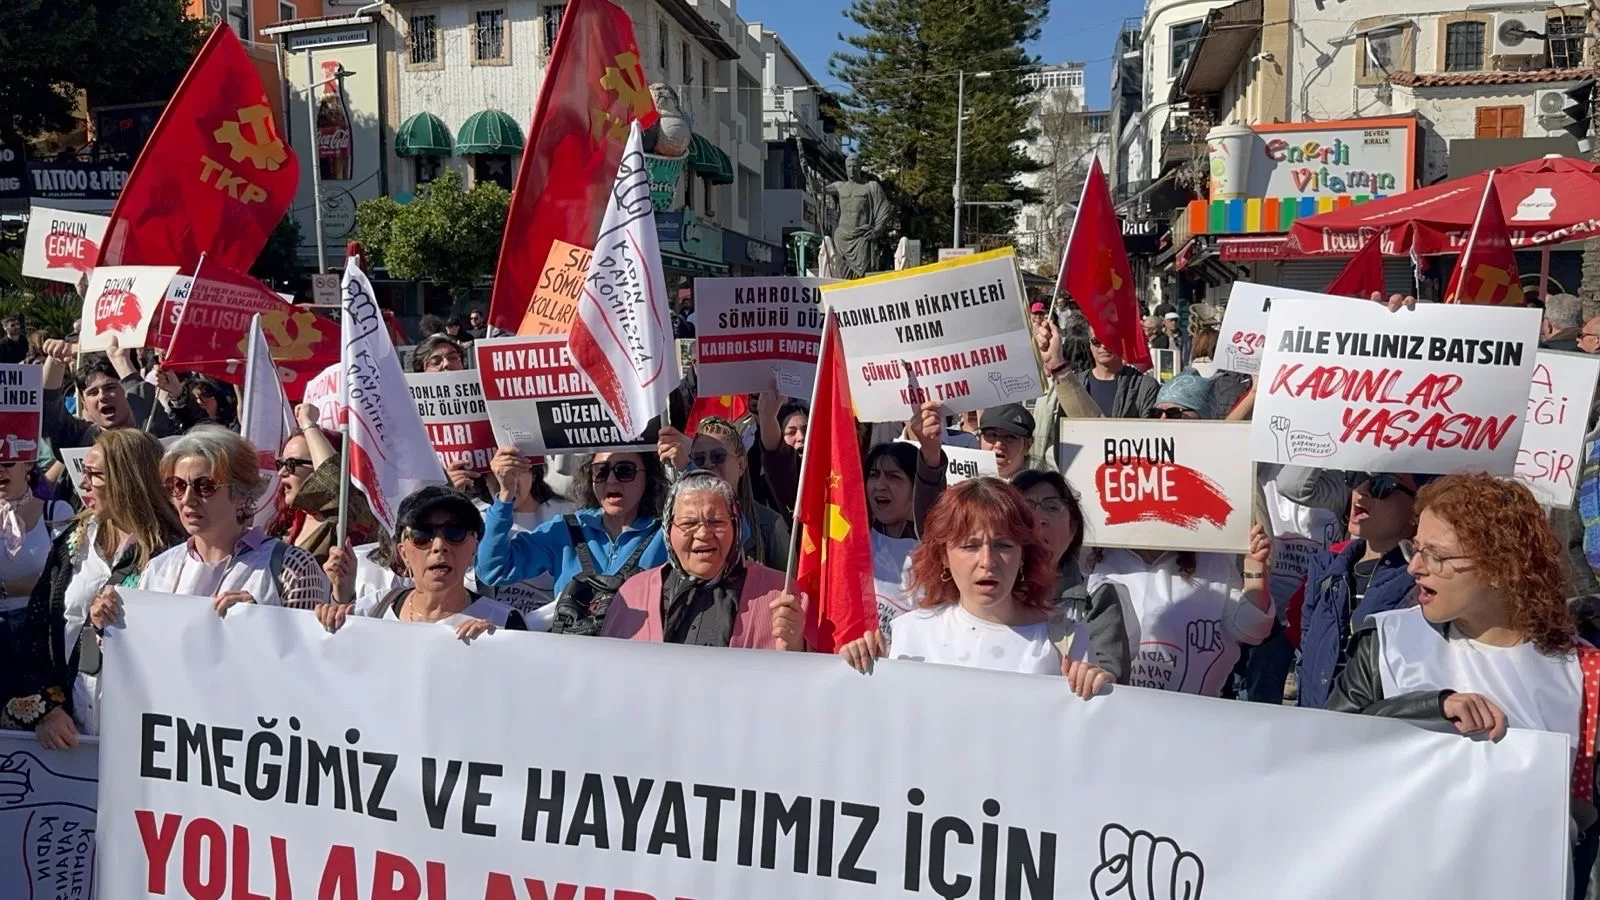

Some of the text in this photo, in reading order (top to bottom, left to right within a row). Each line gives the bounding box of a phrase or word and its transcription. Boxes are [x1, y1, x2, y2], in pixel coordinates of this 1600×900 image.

[31, 169, 88, 190] TATTOO
[89, 171, 101, 190] &
[200, 155, 267, 205] TKP
[51, 219, 87, 239] BOYUN
[540, 266, 587, 302] SÖMÜ
[612, 240, 646, 304] KADIN
[102, 276, 137, 297] BOYUN
[735, 286, 822, 304] KAHROLSU
[834, 279, 1006, 328] KADINLARIN HİKAYELERİ
[718, 307, 826, 329] SÖMÜRÜ DÜZ
[895, 319, 944, 344] YARIM
[492, 346, 575, 372] HAYALLE
[701, 339, 820, 356] KAHROLSUN EMPER
[1278, 325, 1524, 367] AİLE YILINIZ BATSIN
[862, 344, 1008, 387] ÇÜNKÜ PATRONLARIN
[935, 379, 971, 401] TAM
[1269, 363, 1463, 413] KADINLAR
[418, 401, 436, 416] BİZ
[1339, 407, 1517, 452] YAŞASIN
[1104, 437, 1175, 466] BOYUN
[949, 458, 979, 478] değil
[1104, 464, 1179, 503] EĞME
[140, 712, 1057, 900] EMEĞİMİZ VE HAYATIMIZ İÇİN
